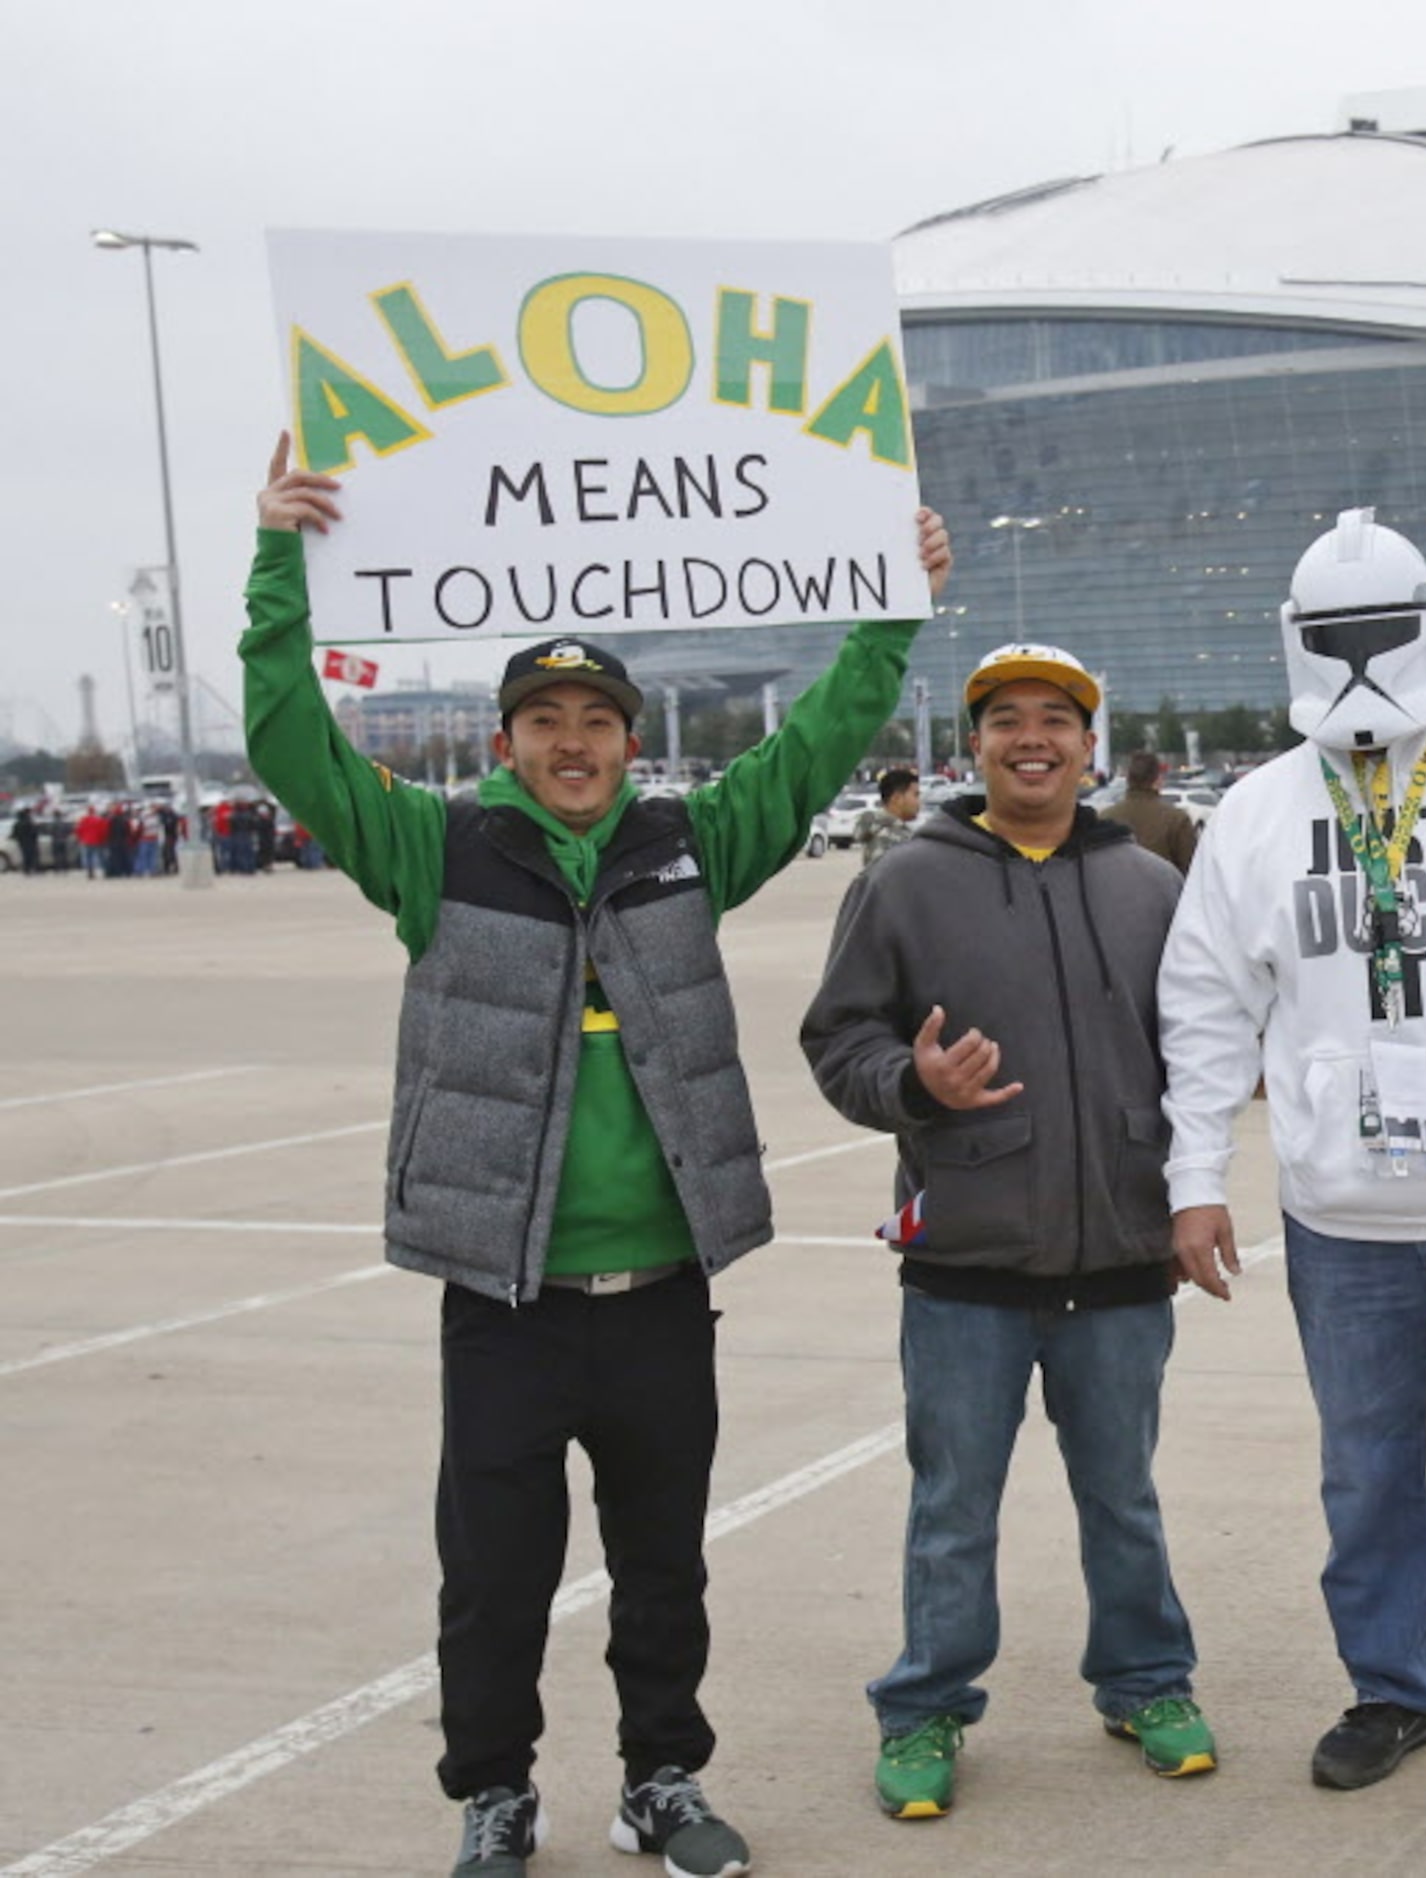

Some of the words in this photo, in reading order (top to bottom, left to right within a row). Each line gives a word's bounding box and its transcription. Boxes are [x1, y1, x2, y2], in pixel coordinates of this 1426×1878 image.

[292, 271, 912, 477] ALOHA
[484, 453, 770, 527] MEANS
[354, 553, 890, 633] TOUCHDOWN
[143, 625, 172, 672] 10
